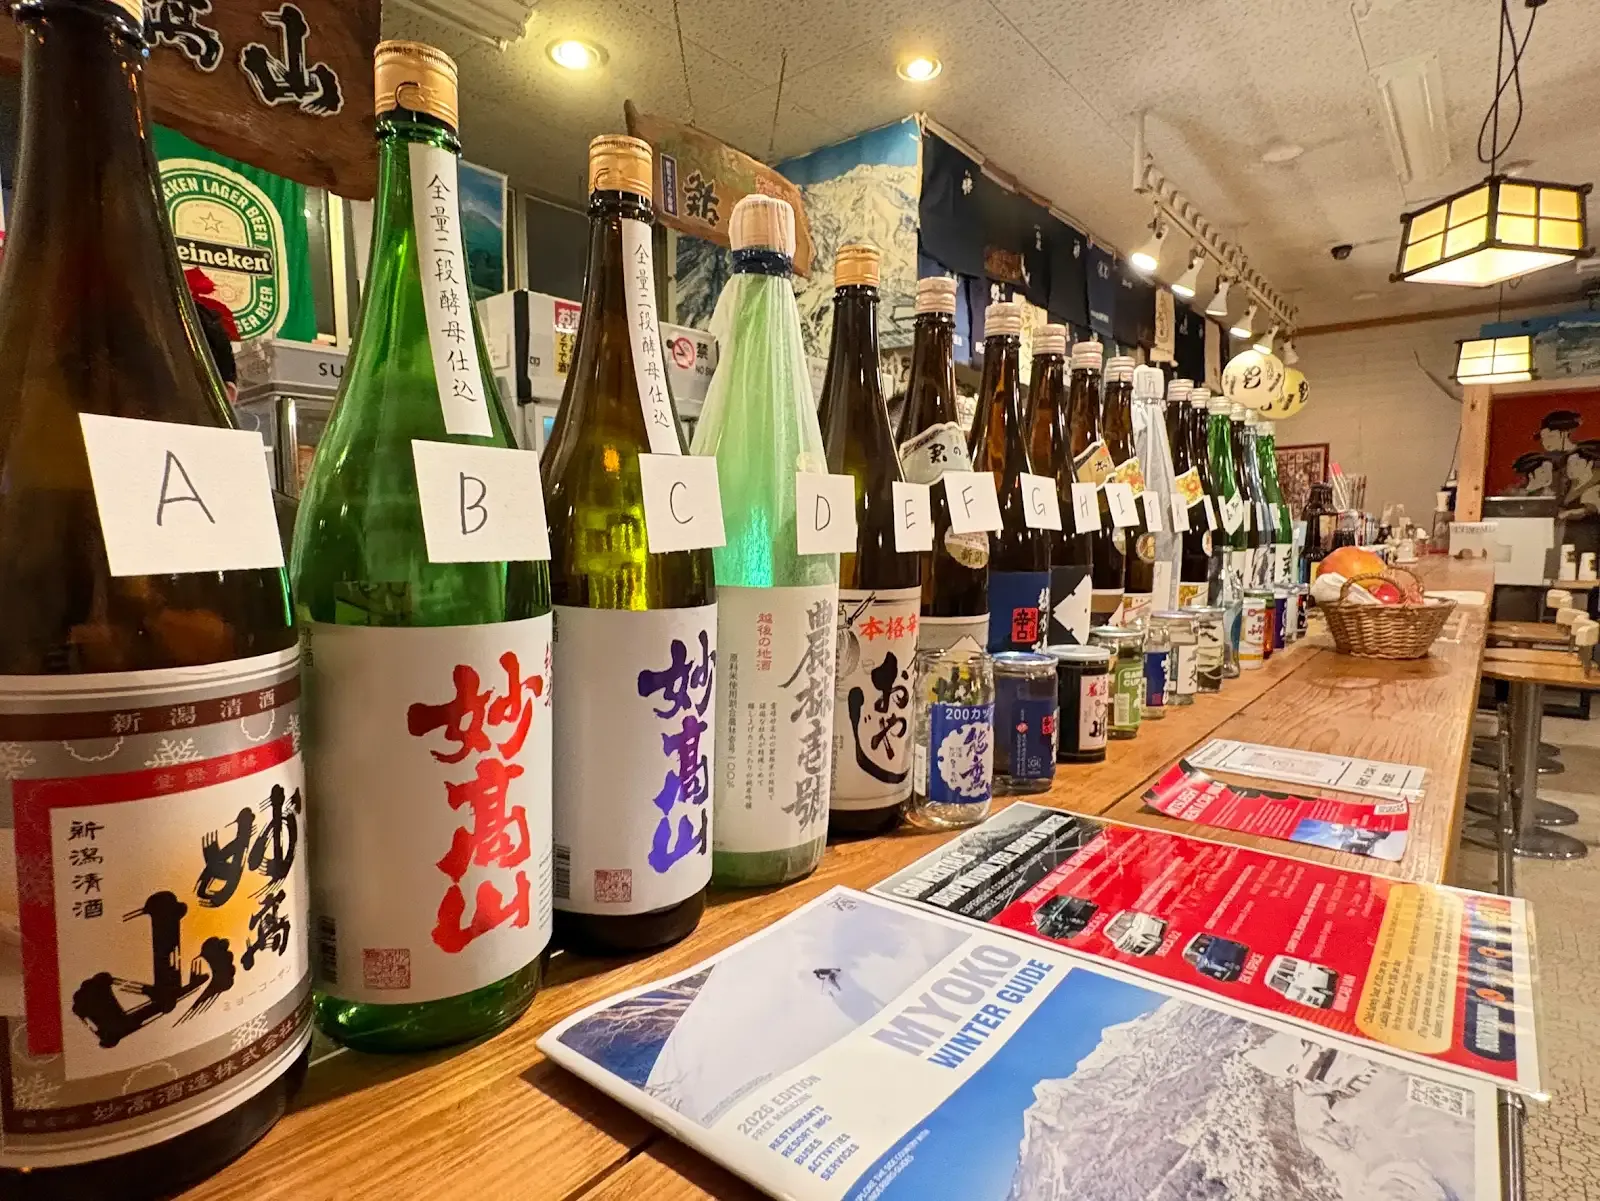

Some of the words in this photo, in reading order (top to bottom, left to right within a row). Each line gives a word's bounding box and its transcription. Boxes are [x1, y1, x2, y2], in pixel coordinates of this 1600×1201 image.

[203, 179, 249, 210] LAGER
[245, 206, 268, 241] BEER
[177, 242, 269, 272] eineken
[257, 286, 274, 317] BEER
[425, 173, 479, 403] 全量二段酵母仕込
[633, 243, 671, 429] 全量二段酵母仕込
[319, 362, 344, 378] SU
[156, 450, 216, 527] A
[459, 471, 489, 536] B
[669, 481, 695, 525] C
[961, 485, 974, 519] F
[1031, 487, 1046, 516] G
[1079, 495, 1090, 519] H
[814, 493, 832, 532] D
[904, 499, 917, 530] E
[756, 611, 774, 672] 越後の地酒
[110, 689, 277, 733] 新潟清酒
[847, 651, 912, 785] おやじ
[637, 628, 717, 875] 妙高山
[406, 650, 544, 955] 妙高山
[66, 819, 105, 919] 新潟清酒
[870, 945, 1022, 1057] MYOKO
[927, 1003, 1012, 1070] WINTER
[996, 958, 1055, 1005] GUIDE
[737, 1104, 775, 1136] 2026
[772, 1074, 821, 1107] EDITION
[751, 1117, 779, 1142] FREE
[768, 1104, 825, 1152] RESTAURANTS
[780, 1125, 816, 1158] RESORT
[794, 1137, 823, 1166] BUSES
[807, 1132, 852, 1175] ACTIVITIES
[820, 1142, 860, 1182] SERVICES
